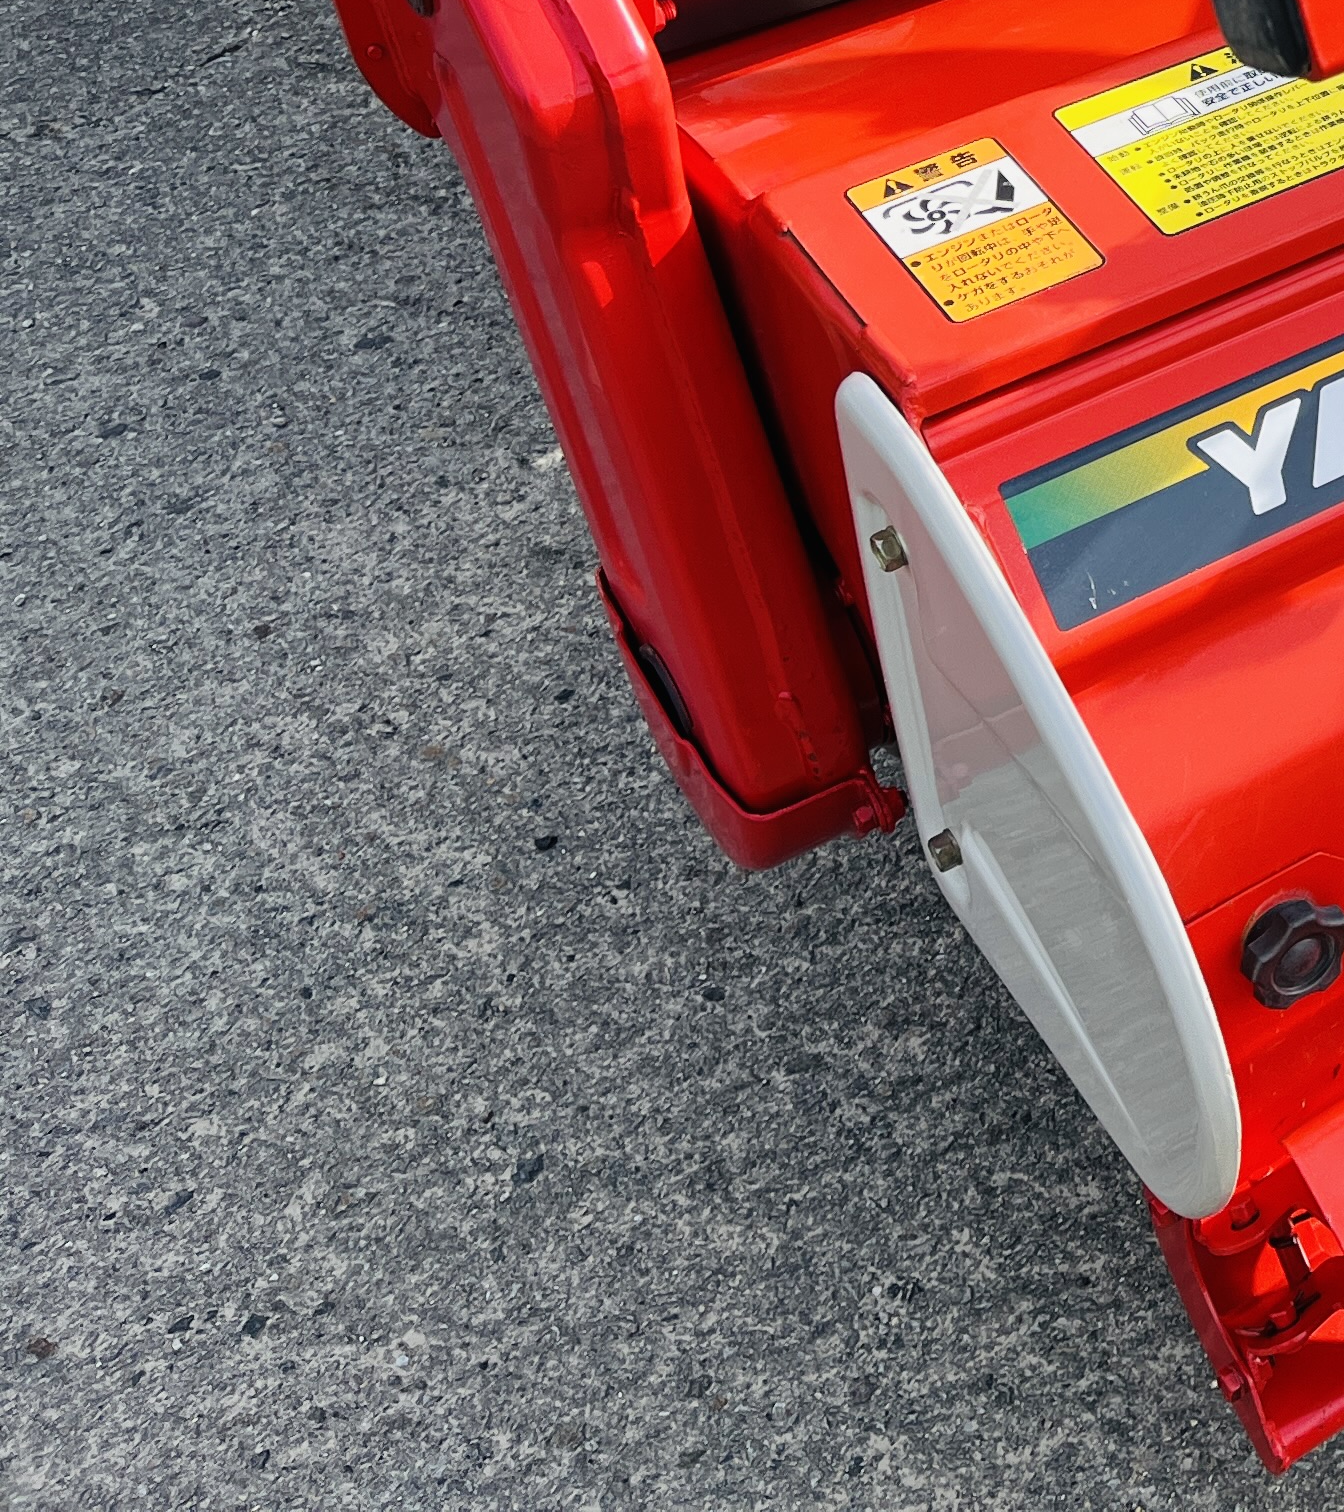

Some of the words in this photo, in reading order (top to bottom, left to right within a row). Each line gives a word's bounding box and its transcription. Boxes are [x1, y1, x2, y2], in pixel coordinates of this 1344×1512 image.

[1192, 66, 1268, 99] 使用前に取
[922, 206, 1054, 262] エンジンまたはロータ
[939, 225, 1071, 282] をロータリの中や下へ
[946, 238, 1074, 292] 入れないでください。
[955, 249, 1077, 301] ケガをするおそれが
[963, 282, 1026, 312] あります。
